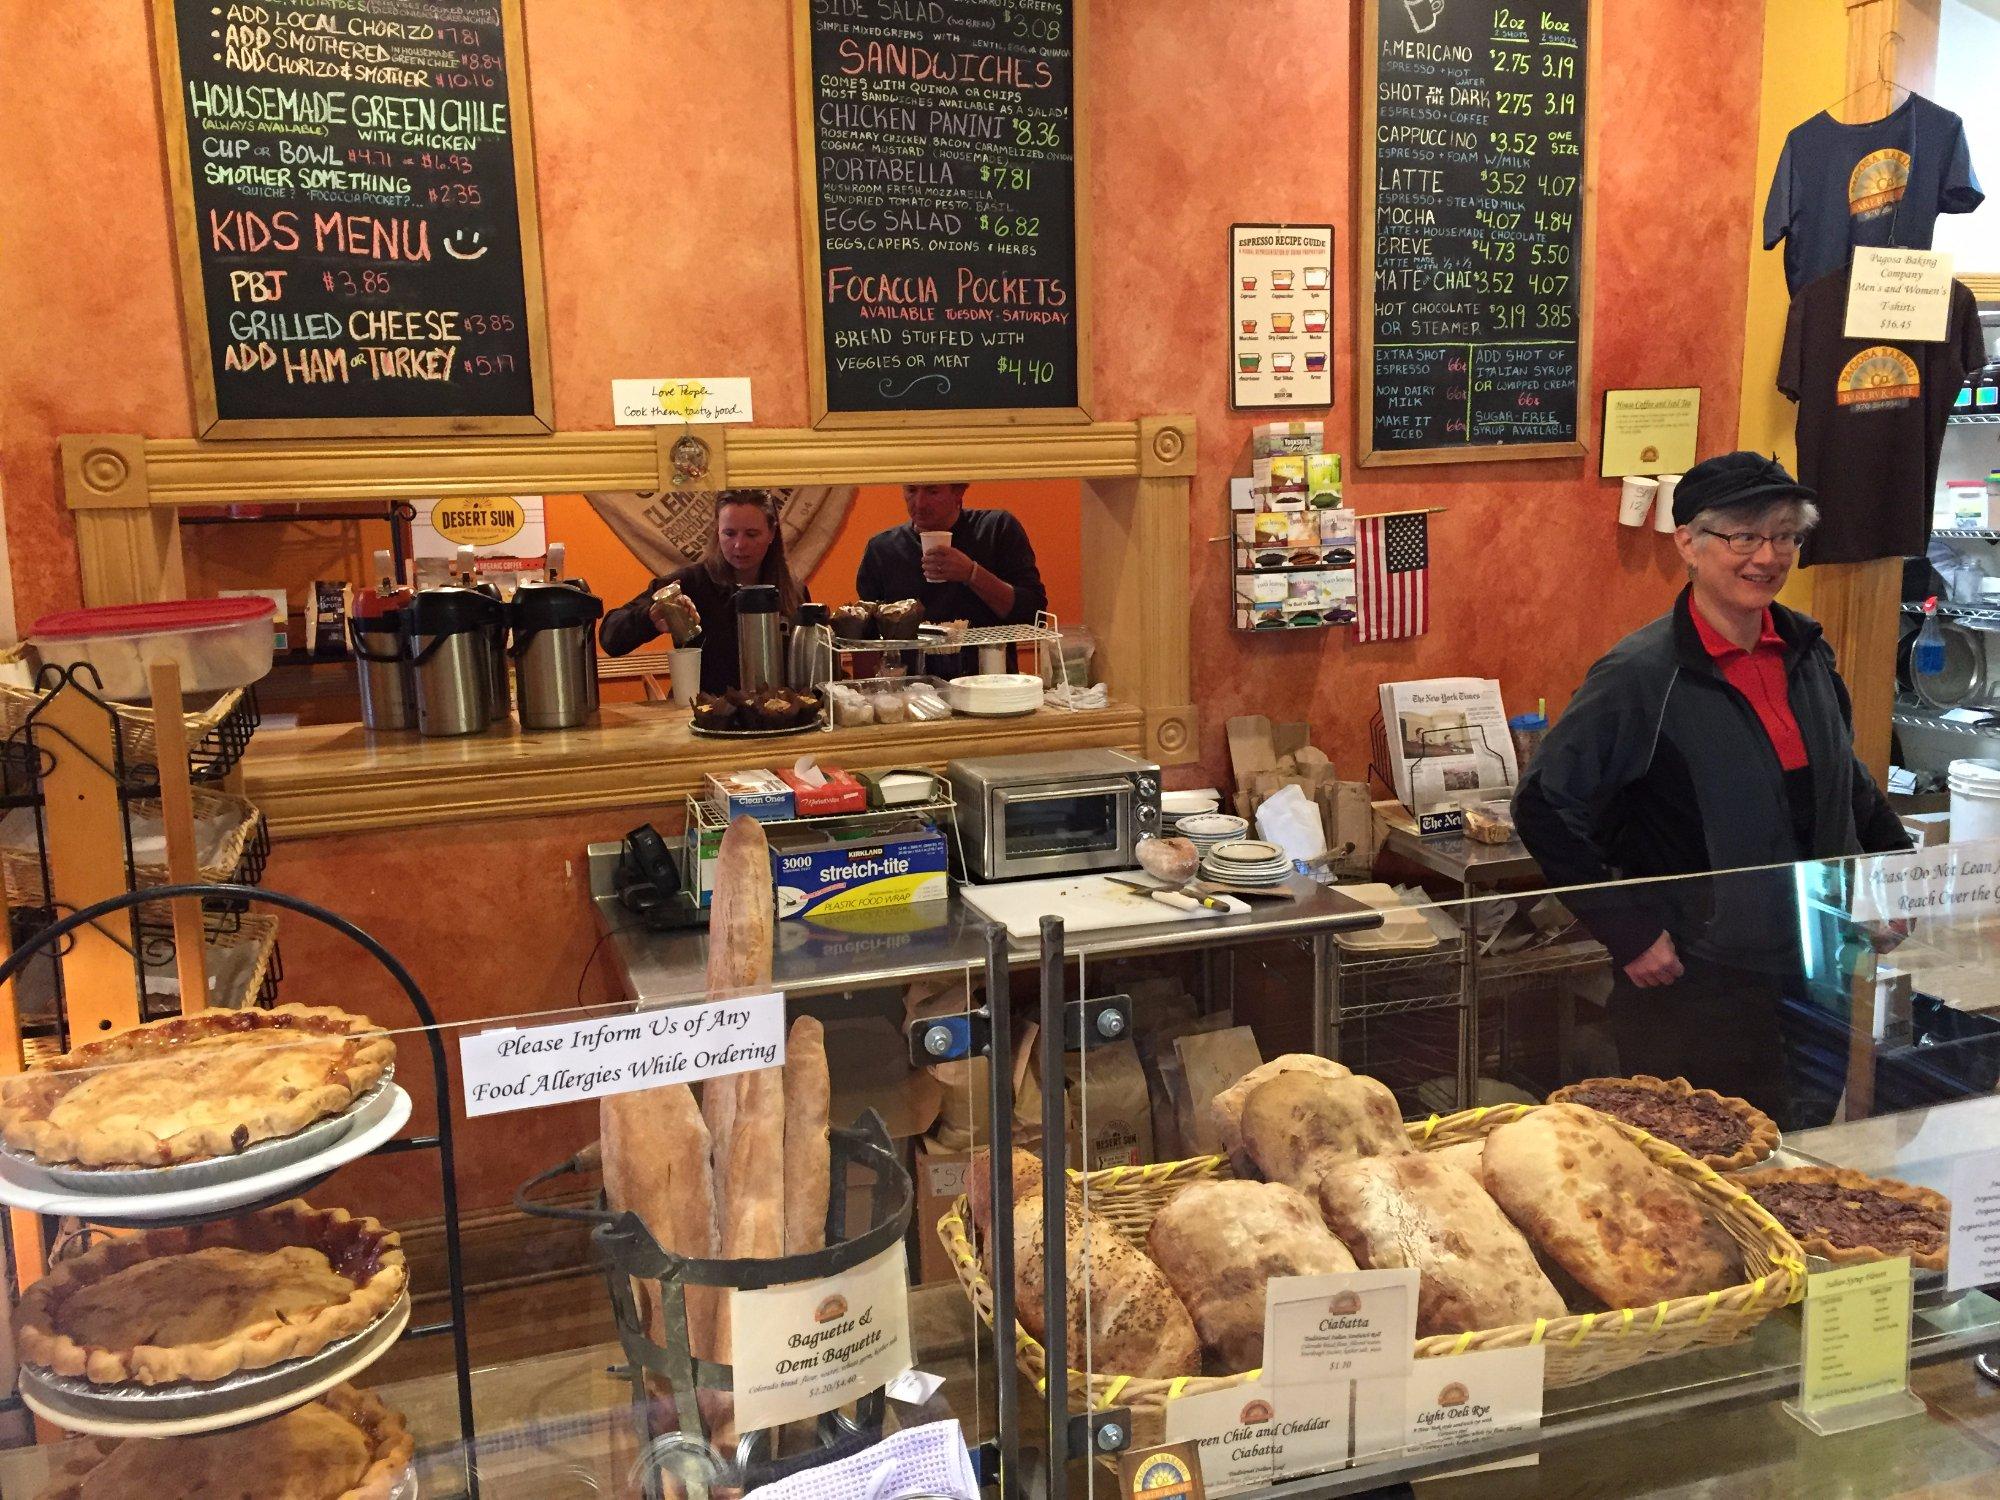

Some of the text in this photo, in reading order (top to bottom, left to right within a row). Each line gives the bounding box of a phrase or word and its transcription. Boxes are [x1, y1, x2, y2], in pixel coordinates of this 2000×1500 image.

[227, 4, 435, 40] ADD LOCAL CHORIZO
[1493, 8, 1570, 33] 12oz 16oz
[226, 25, 391, 62] ADD SMOTHERED
[839, 38, 1053, 89] SANDWICHES
[1382, 40, 1575, 79] AMERICANO $2.75 3.19
[820, 74, 1022, 103] COMES WITH QUINOA OR CHIPS
[190, 81, 508, 135] HOUSEMADE GREEN CHILE
[202, 118, 329, 138] (ALWAYS AVAILABLE)
[820, 102, 1060, 148] CHICKEN PANINI $8.36
[821, 127, 927, 146] ROSEMARY CHICKEN
[202, 137, 252, 158] CUP
[280, 140, 344, 165] BOWL
[359, 129, 478, 151] WITH CHICKEN
[821, 140, 925, 158] COGNAC MUSTARD
[1377, 125, 1539, 155] CAPPUCCINO $3.52
[204, 162, 411, 194] SMOTHER SOMETHING
[823, 156, 1031, 190] PORTABELLA $7.81
[1379, 167, 1445, 193] LATTE
[1537, 174, 1576, 197] 4.07
[824, 207, 1041, 237] EGG SALAD $6.82
[1377, 207, 1436, 226] MOCHA
[1534, 211, 1572, 233] 4.84
[210, 208, 432, 261] KIDS MENU
[1239, 235, 1326, 248] ESPRESSO RECIPE GUIDE
[1377, 236, 1570, 265] BREVE $4.73 5.50
[1904, 255, 1938, 268] Baking
[230, 270, 391, 302] PBJ $3.85
[828, 266, 1067, 306] FOCACCIA POCKETS
[1880, 269, 1924, 281] Company
[1883, 285, 1901, 294] and
[1904, 285, 1947, 297] Women's
[860, 306, 1070, 325] AVAILABLE TUESDAY SATURDAY
[1375, 301, 1480, 316] HOT CHOCOLATE
[229, 310, 462, 341] GRILLED CHEESE
[1411, 321, 1482, 336] STEAMER
[1879, 319, 1912, 329] $16.45
[834, 327, 1025, 349] BREAD STUFFED WITH
[224, 342, 456, 384] ADD HAM TURKEY
[1376, 349, 1446, 362] EXTRA SHOT
[837, 354, 1055, 386] VEGGIES OR MEAT $4.40
[1376, 364, 1430, 376] ESPRESSO
[1476, 365, 1573, 378] ITALIAN SYRUP
[652, 384, 715, 399] Love People
[624, 406, 648, 417] Cook
[650, 406, 682, 417] them
[685, 406, 712, 419] tasty
[441, 509, 515, 530] DESERT SUN
[1412, 694, 1426, 704] The
[1440, 693, 1458, 704] York
[1458, 692, 1481, 701] Times
[739, 794, 786, 806] Clean Ones
[1422, 816, 1443, 830] The
[782, 856, 813, 870] 3000
[849, 847, 884, 859] KIRKLAND
[819, 857, 910, 882] stretch-tite
[1910, 866, 1930, 881] Do
[1960, 861, 1992, 876] Lean
[824, 899, 858, 912] PLASTIC
[859, 896, 883, 908] FOOD
[883, 892, 911, 905] WRAP
[1898, 890, 1936, 911] Reach
[1971, 884, 1991, 901] the
[497, 1009, 751, 1058] Please Inform Us of Any
[472, 1042, 777, 1102] Food Allergies While Ordering
[787, 1305, 874, 1350] Baguette &
[1318, 1316, 1370, 1331] Ciabatta
[775, 1351, 820, 1375] Demi
[822, 1329, 883, 1363] Baguette
[1416, 1409, 1445, 1425] Light
[1447, 1405, 1470, 1419] Deli
[1471, 1405, 1491, 1418] Rye
[1192, 1417, 1331, 1448] reen Chile and Cheddar
[1231, 1443, 1283, 1461] Ciabatta
